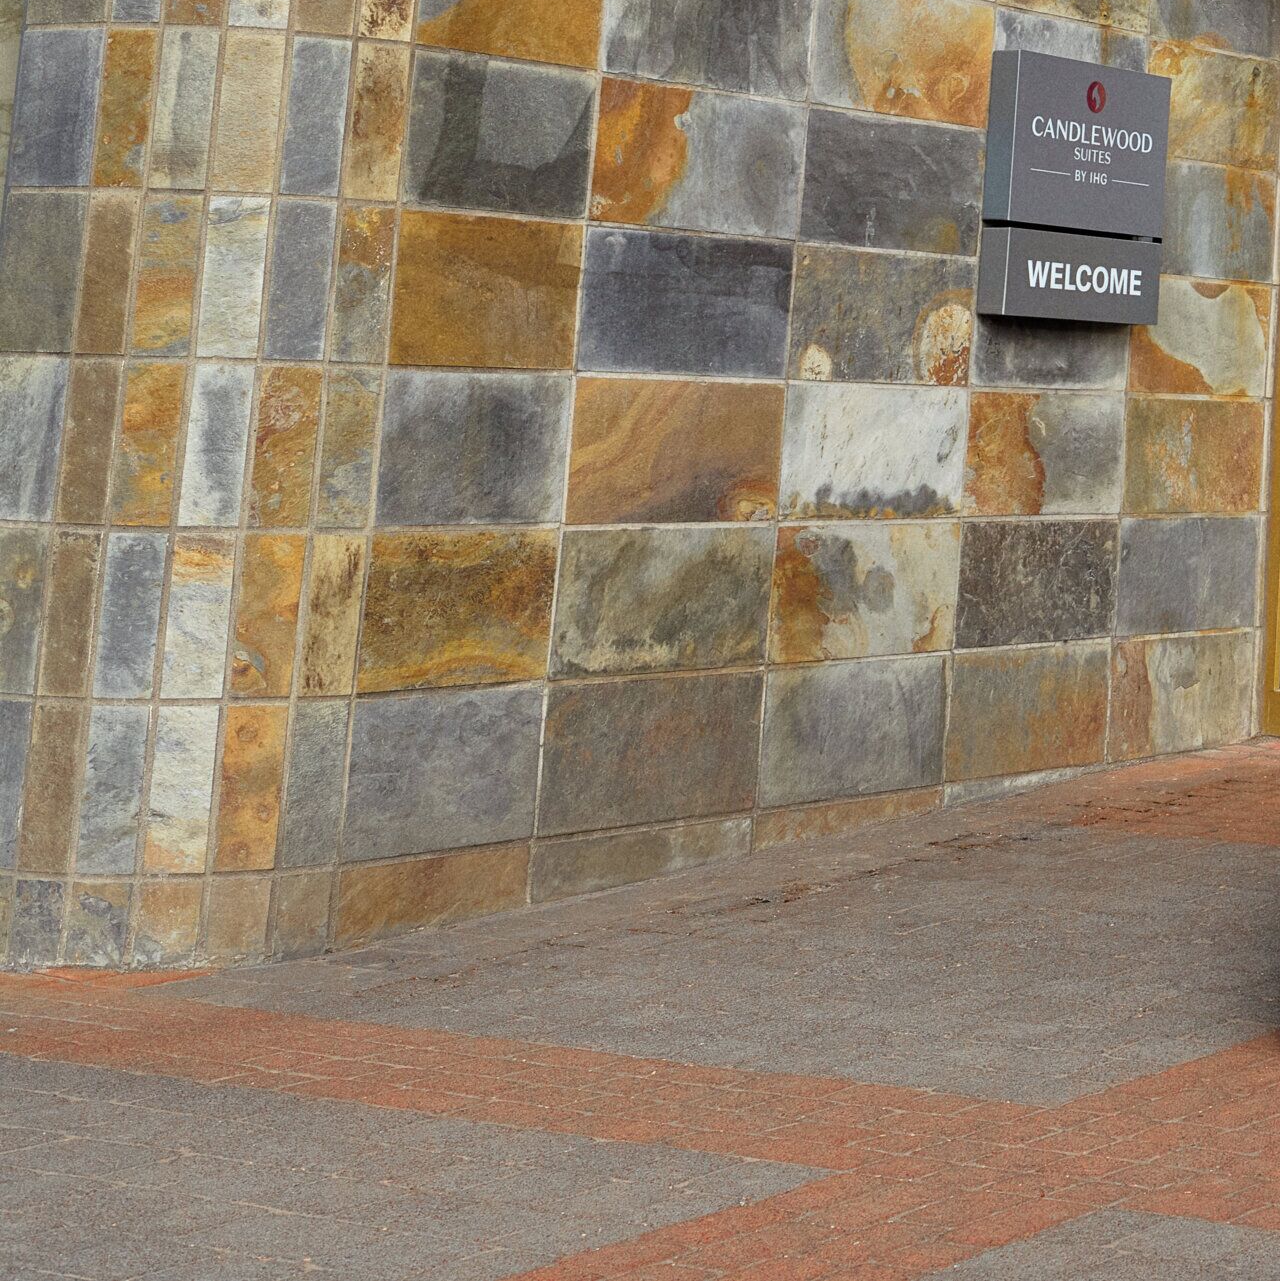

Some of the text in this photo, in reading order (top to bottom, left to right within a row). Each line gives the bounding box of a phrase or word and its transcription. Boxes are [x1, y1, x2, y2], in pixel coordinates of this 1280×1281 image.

[1032, 115, 1153, 153] CANDLEWOOD
[1073, 147, 1112, 165] SUITES
[1074, 169, 1108, 186] BY IHG
[1027, 259, 1142, 296] WELCOME
